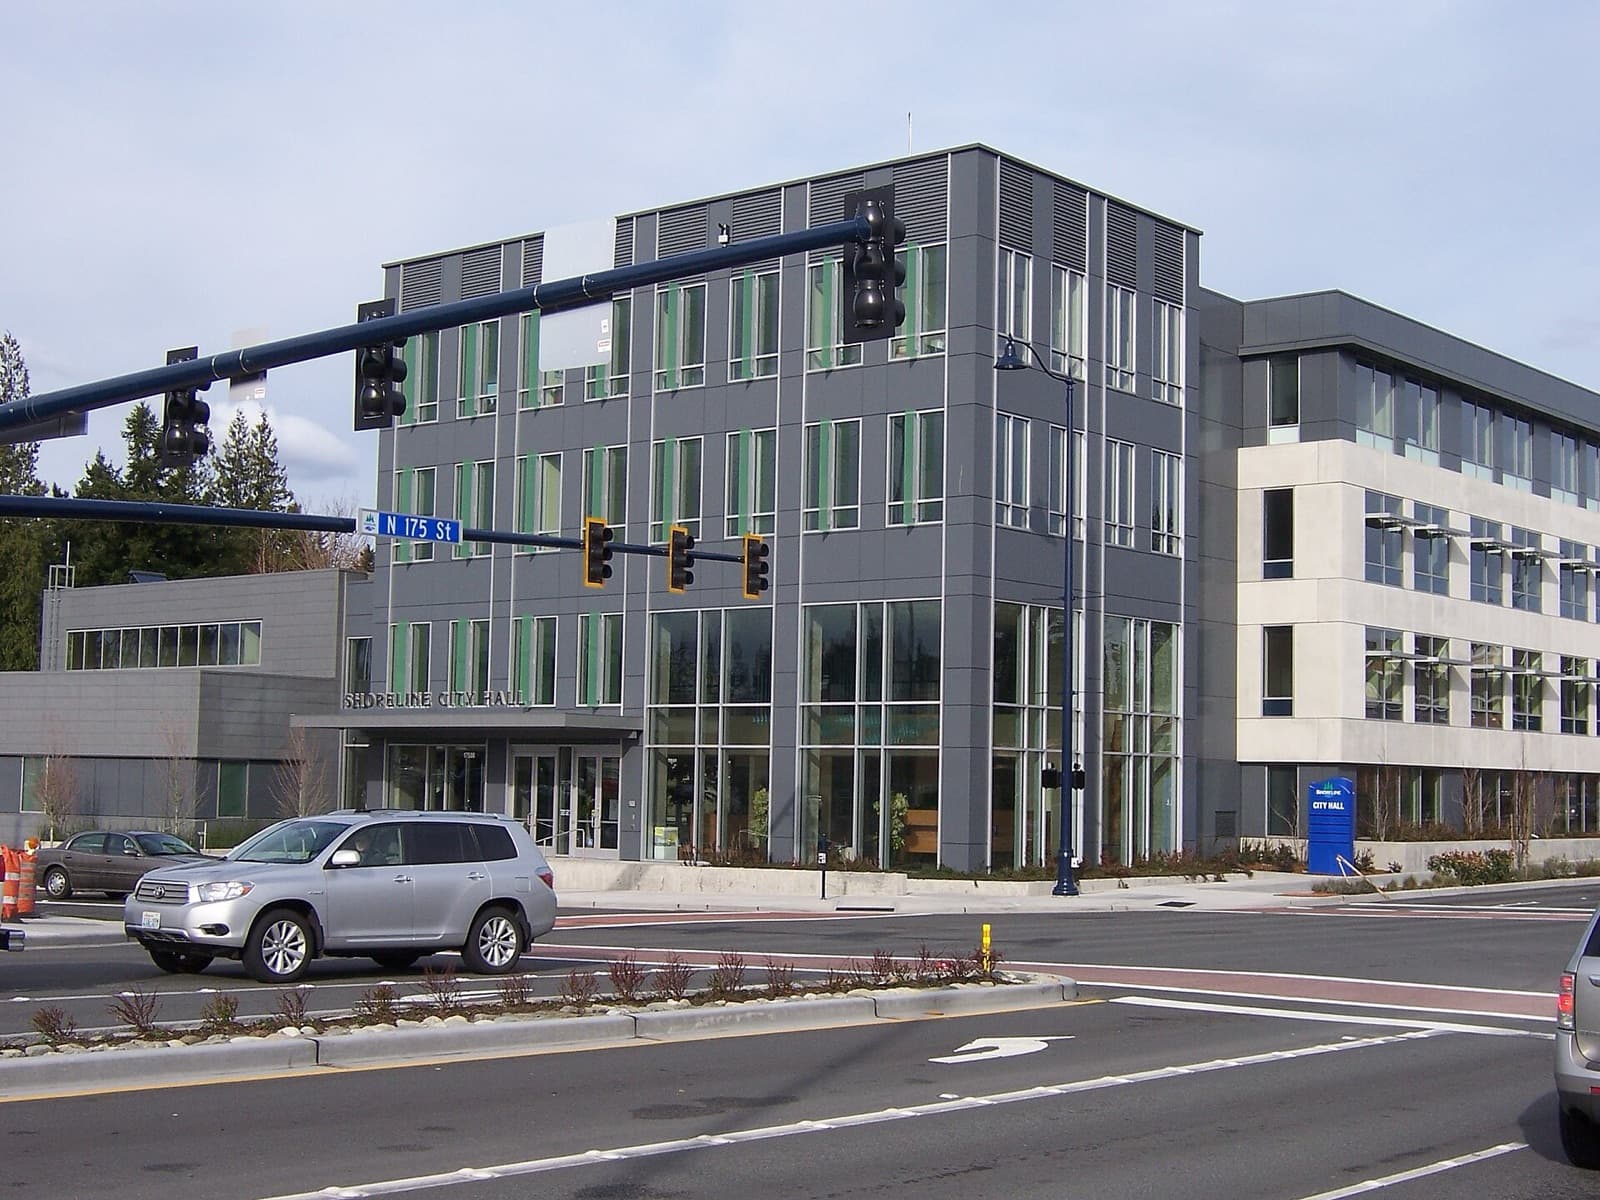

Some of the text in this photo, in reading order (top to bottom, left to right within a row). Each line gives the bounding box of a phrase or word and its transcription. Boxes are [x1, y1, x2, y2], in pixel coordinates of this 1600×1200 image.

[387, 515, 452, 541] N 175 St
[344, 690, 526, 709] SHORELINE CITY HALL
[1313, 801, 1344, 810] CITY HALL
